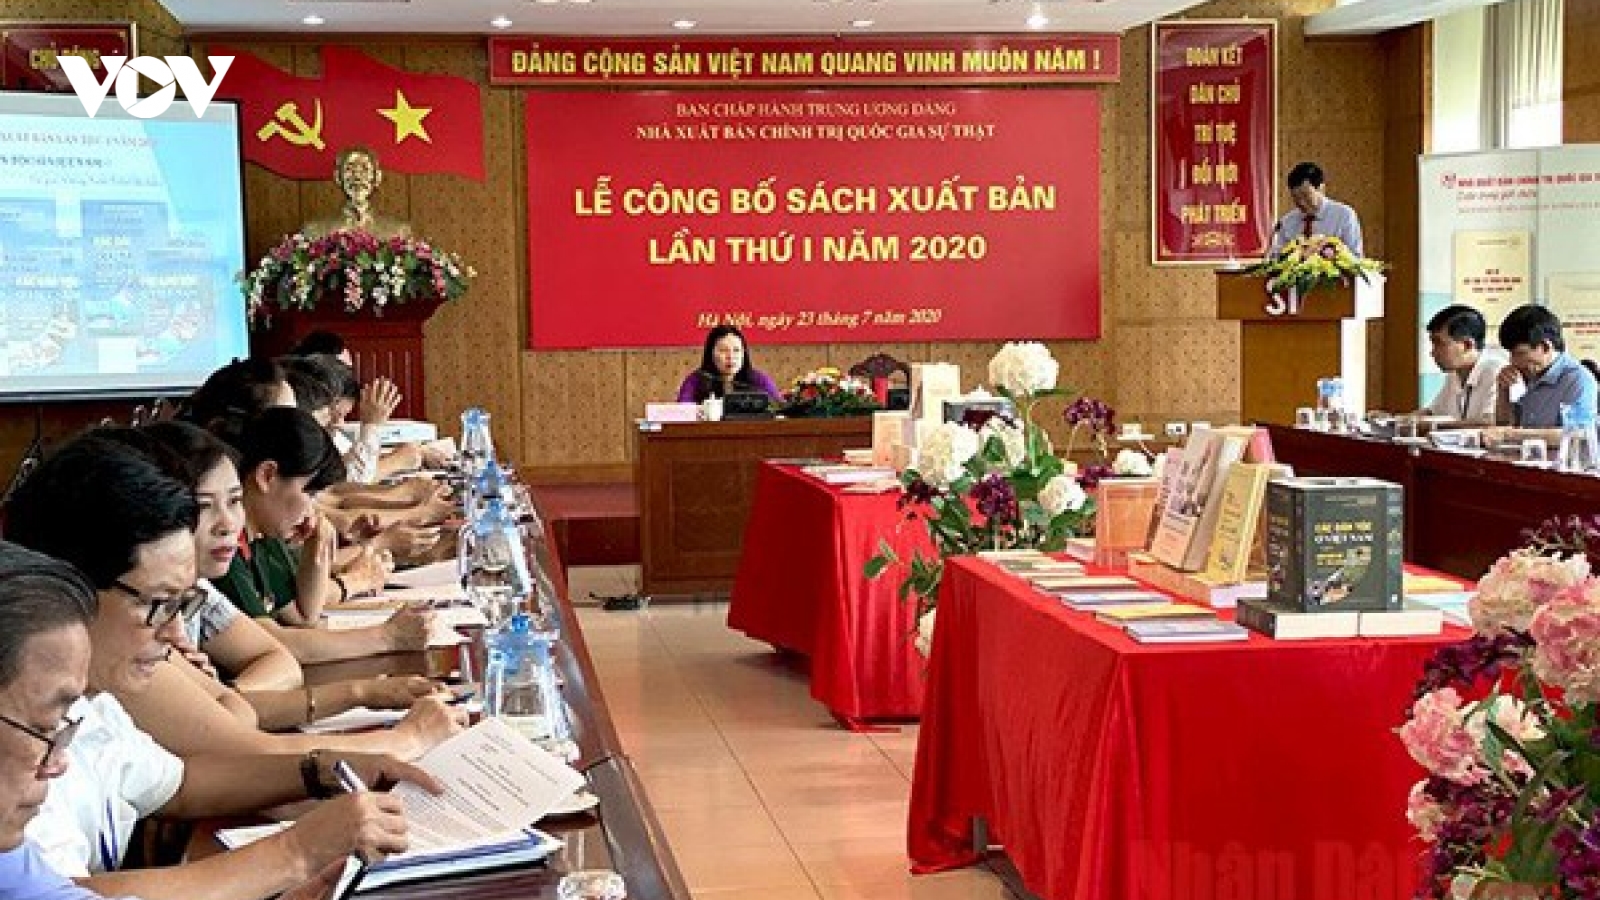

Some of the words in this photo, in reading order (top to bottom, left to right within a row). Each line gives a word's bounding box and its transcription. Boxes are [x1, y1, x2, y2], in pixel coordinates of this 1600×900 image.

[511, 42, 577, 73] ĐẢNG
[583, 47, 646, 79] CỘNG
[653, 43, 701, 73] SẢN
[707, 47, 755, 79] VIỆT
[762, 52, 814, 73] NAM
[820, 52, 897, 75] QUANG
[903, 52, 955, 73] VINH
[962, 46, 1028, 72] MUÔN
[1034, 45, 1086, 71] NĂM
[676, 103, 710, 117] BAN
[807, 101, 860, 116] TRUNG
[636, 122, 671, 139] NHÀ
[676, 120, 718, 139] XUẤT
[724, 121, 755, 139] BẢN
[759, 121, 812, 139] CHÍNH
[818, 124, 844, 141] TRỊ
[848, 122, 894, 141] QUỐC
[896, 124, 926, 139] GIA
[952, 122, 995, 141] THẬT
[575, 175, 612, 214] LỄ
[623, 181, 721, 214] CÔNG
[730, 175, 777, 214] BỐ
[786, 181, 877, 213] SÁCH
[887, 174, 980, 212] XUẤT
[988, 174, 1056, 211] BẢN
[649, 227, 716, 265] LẦN
[725, 231, 796, 263] THỨ
[803, 237, 813, 262] I
[823, 229, 900, 262] NĂM
[909, 235, 987, 260] 2020
[757, 311, 795, 331] ngày
[797, 310, 815, 326] 23
[816, 310, 860, 328] tháng
[861, 311, 872, 325] 7
[874, 310, 906, 326] năm
[908, 309, 943, 324] 2020
